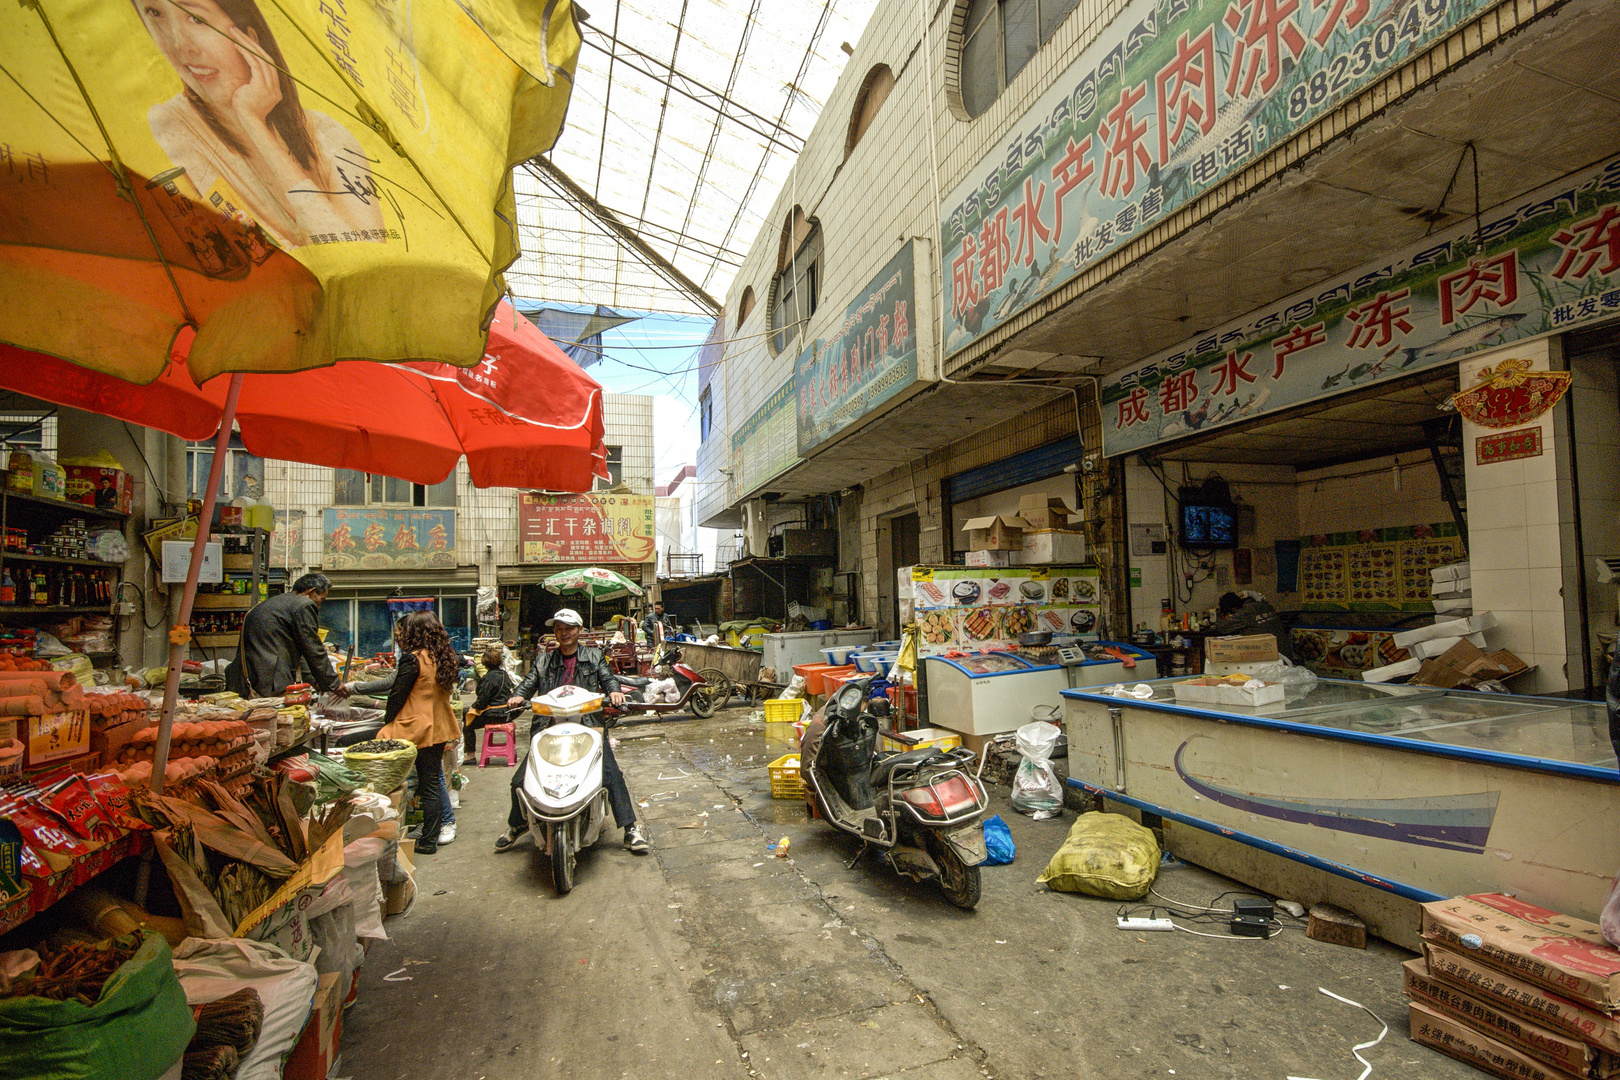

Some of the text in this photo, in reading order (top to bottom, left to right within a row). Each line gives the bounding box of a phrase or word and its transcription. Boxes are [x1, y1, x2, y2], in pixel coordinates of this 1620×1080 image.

[1074, 187, 1164, 267] 批发零售
[1288, 0, 1449, 120] 8823049
[331, 523, 448, 551] 农家饭店
[527, 518, 632, 536] 三汇干杂调料
[1408, 975, 1521, 1038] 永强樱桃谷瘦肉型鲜鸭
[1435, 957, 1562, 1018] 永强樱桃谷瘦肉型鲜鸭
